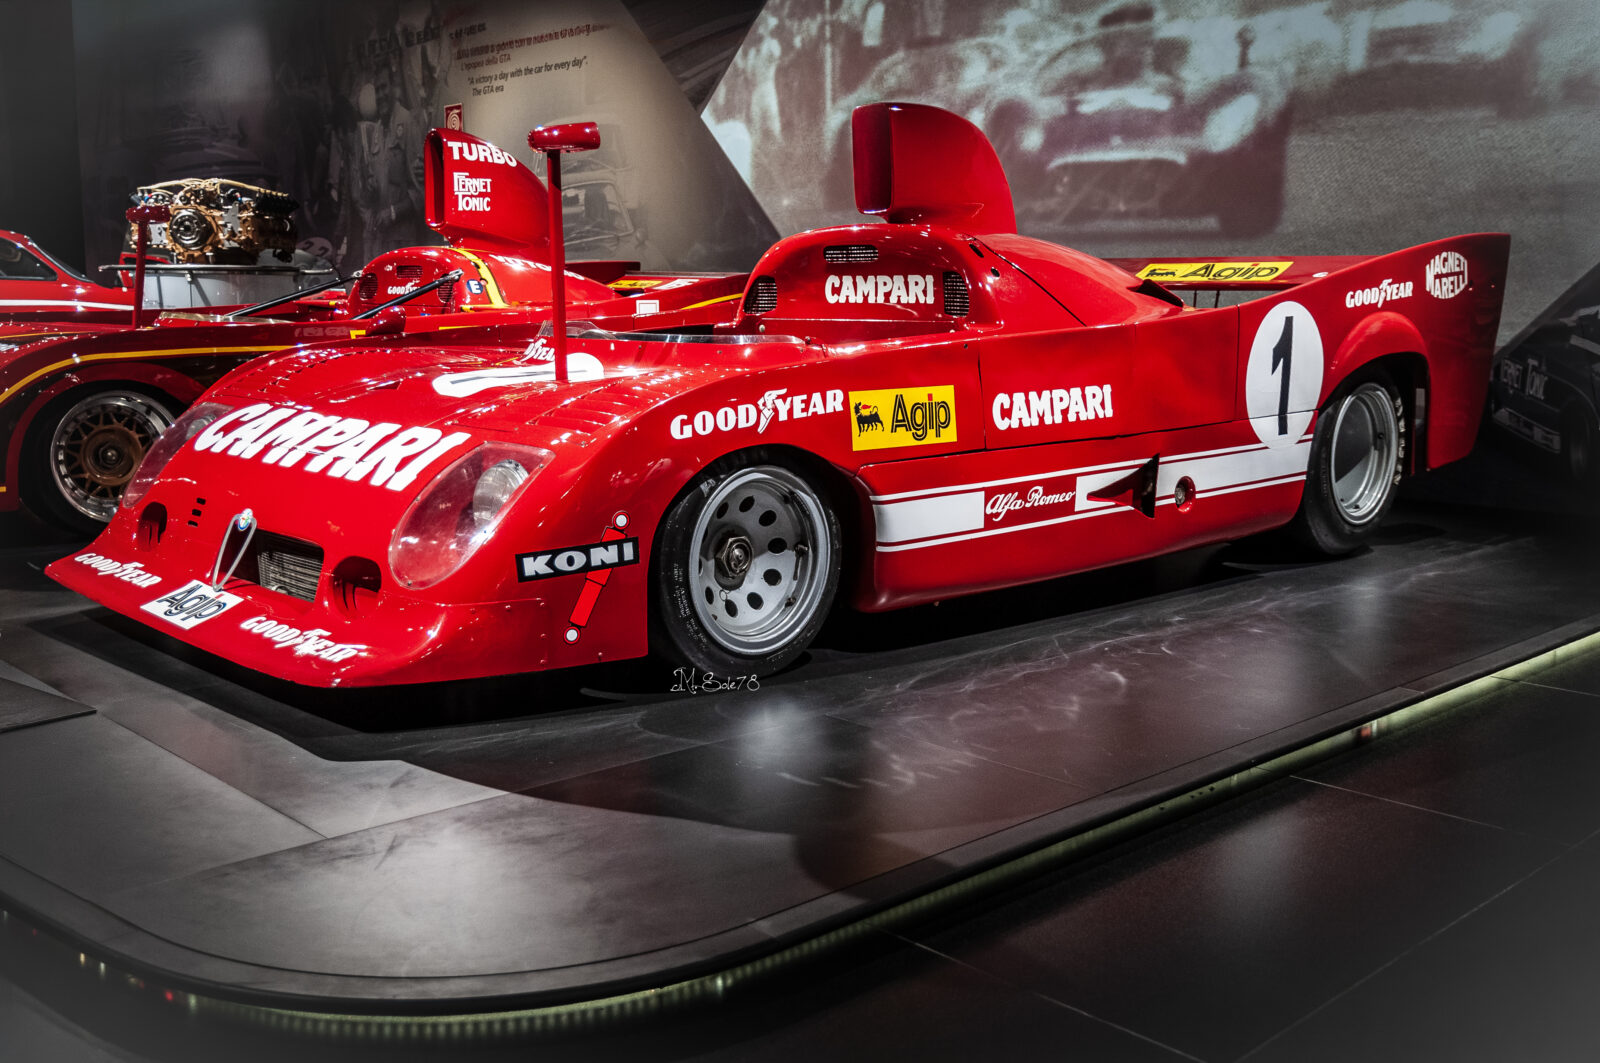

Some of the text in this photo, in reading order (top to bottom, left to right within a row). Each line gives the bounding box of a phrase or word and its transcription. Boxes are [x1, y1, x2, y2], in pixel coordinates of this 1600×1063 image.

[475, 73, 493, 85] victory
[499, 71, 509, 82] day
[510, 69, 523, 78] with
[524, 66, 533, 76] the
[534, 65, 543, 73] car
[544, 62, 553, 72] for
[554, 60, 570, 72] every
[499, 54, 511, 63] GTA
[472, 85, 504, 96] The GTA era
[447, 141, 517, 167] TURBO
[453, 172, 492, 195] FERNET
[454, 192, 491, 211] TONIC
[468, 280, 482, 294] E
[1180, 263, 1280, 280] Agip
[825, 275, 935, 304] CAMPARI
[1345, 278, 1414, 308] GOODYEAR
[1271, 316, 1294, 436] 1
[670, 388, 844, 440] GOODYEAR
[890, 393, 951, 441] Agip
[992, 384, 1114, 430] CAMPARI
[194, 402, 472, 491] CAMPARI
[985, 485, 1076, 521] Alfa Romeo
[74, 552, 162, 588] GOODYEAR
[522, 541, 634, 577] KONI
[156, 584, 227, 621] Agip
[240, 616, 360, 662] GOODYEAR
